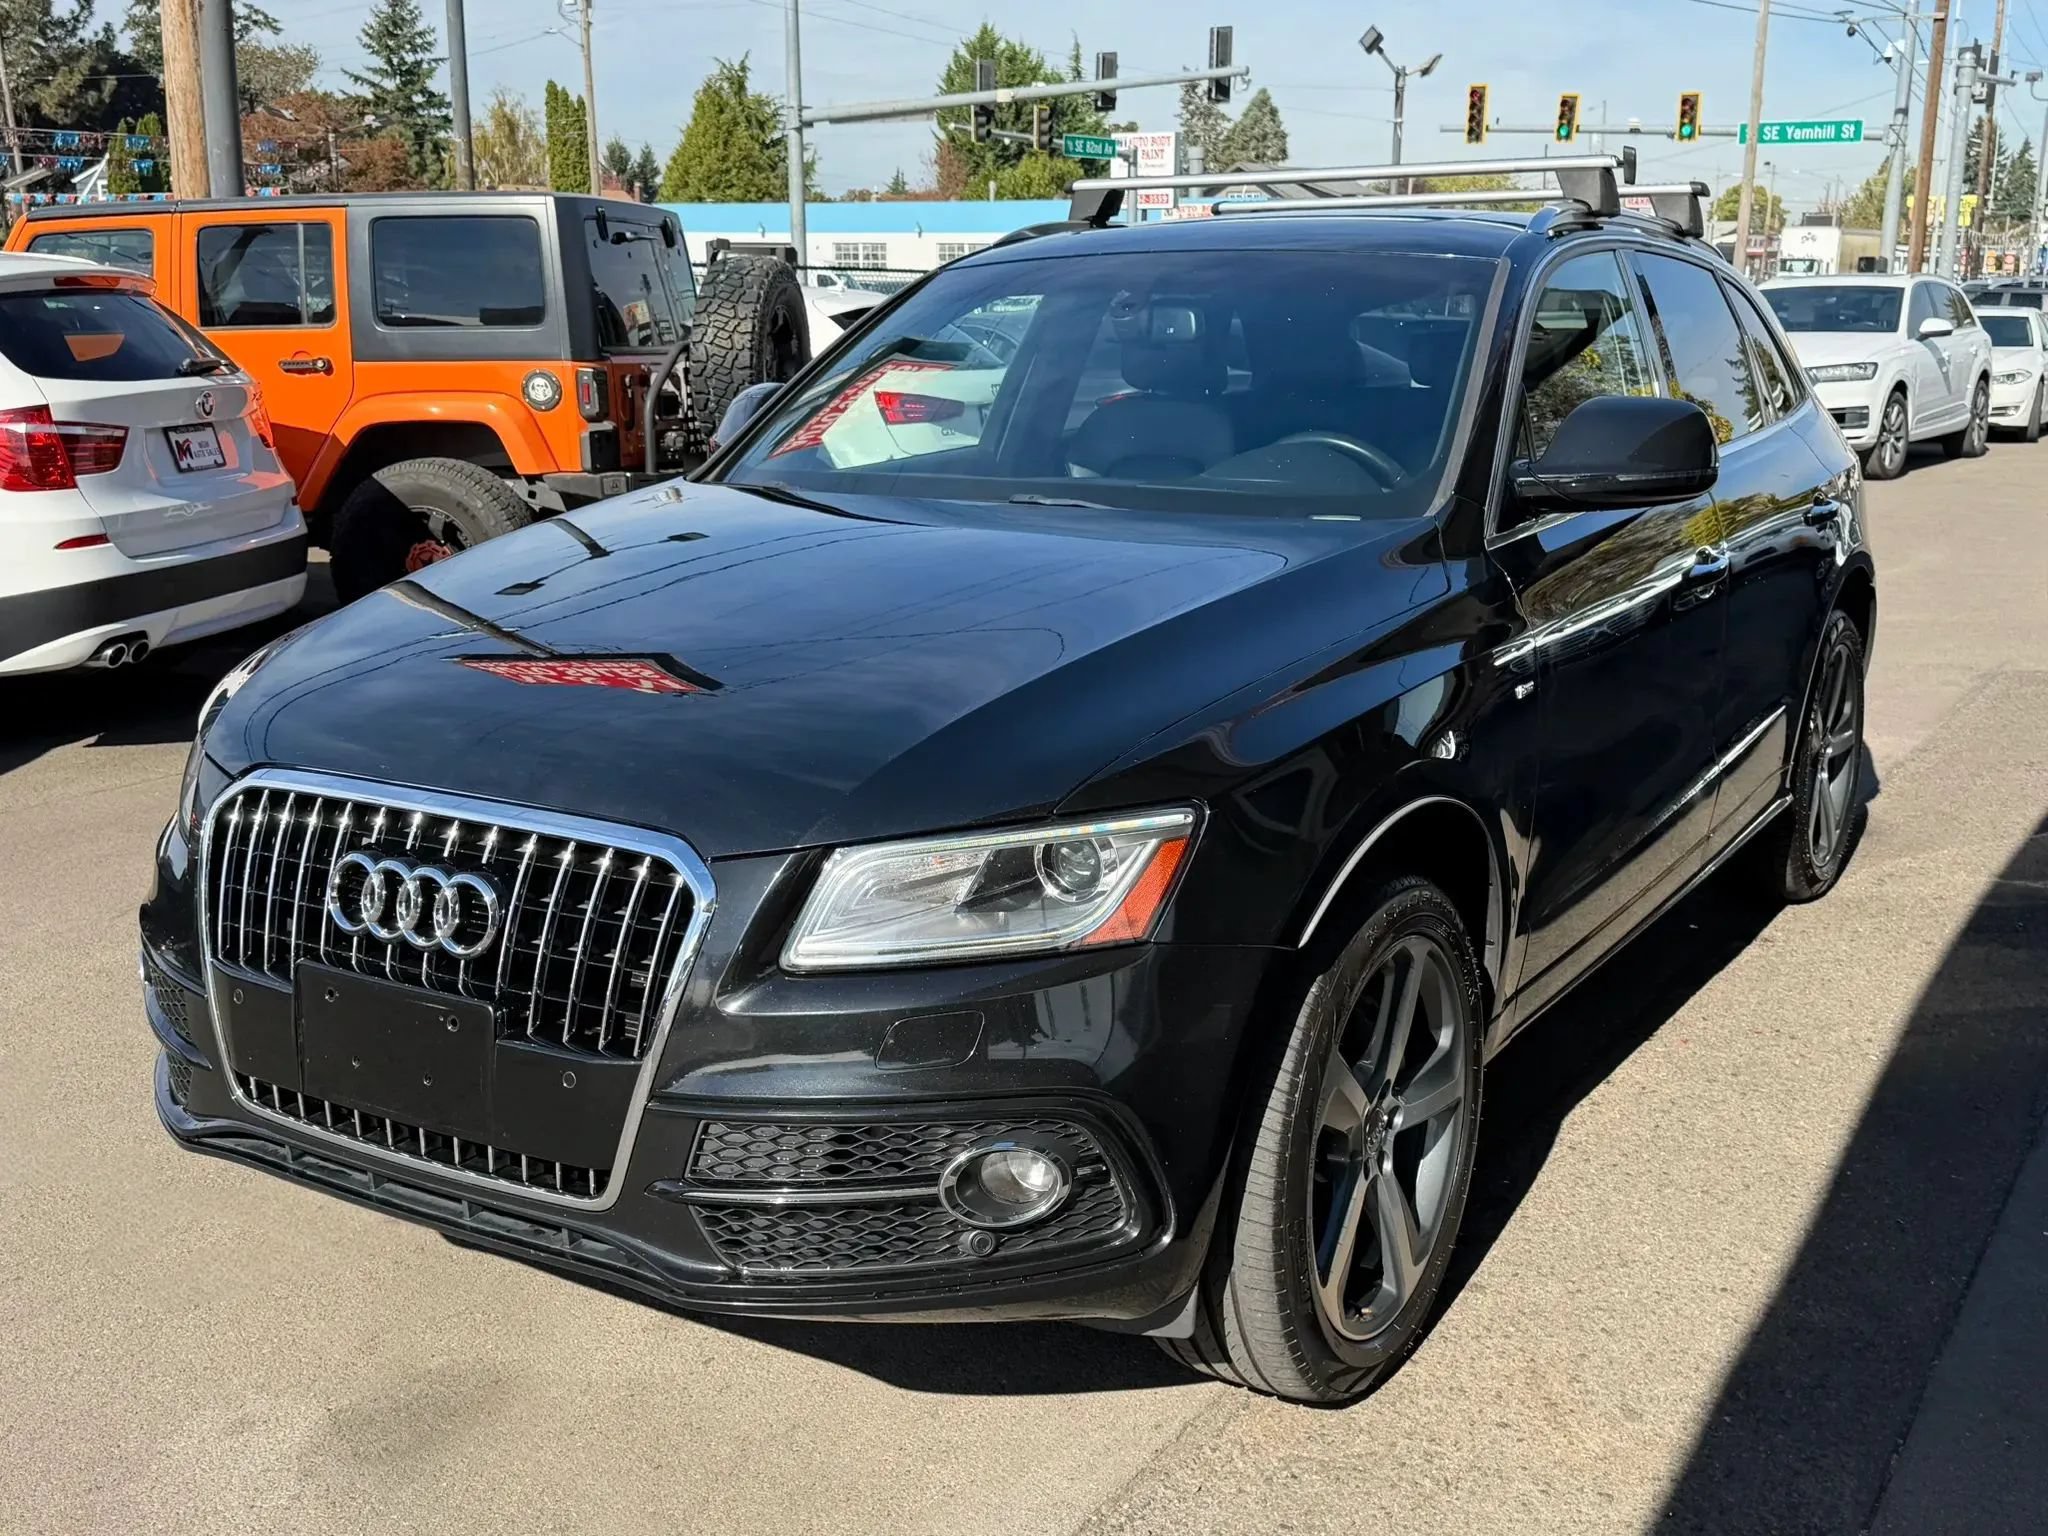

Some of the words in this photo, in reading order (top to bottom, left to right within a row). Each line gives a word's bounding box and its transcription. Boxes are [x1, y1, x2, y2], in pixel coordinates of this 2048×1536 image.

[1763, 125, 1780, 140] SE
[1786, 125, 1835, 140] Yamhill
[1841, 123, 1856, 139] St
[1075, 139, 1084, 153] SE
[1086, 140, 1102, 154] 82nd
[1151, 136, 1171, 147] BODY
[1141, 149, 1165, 160] PAINT
